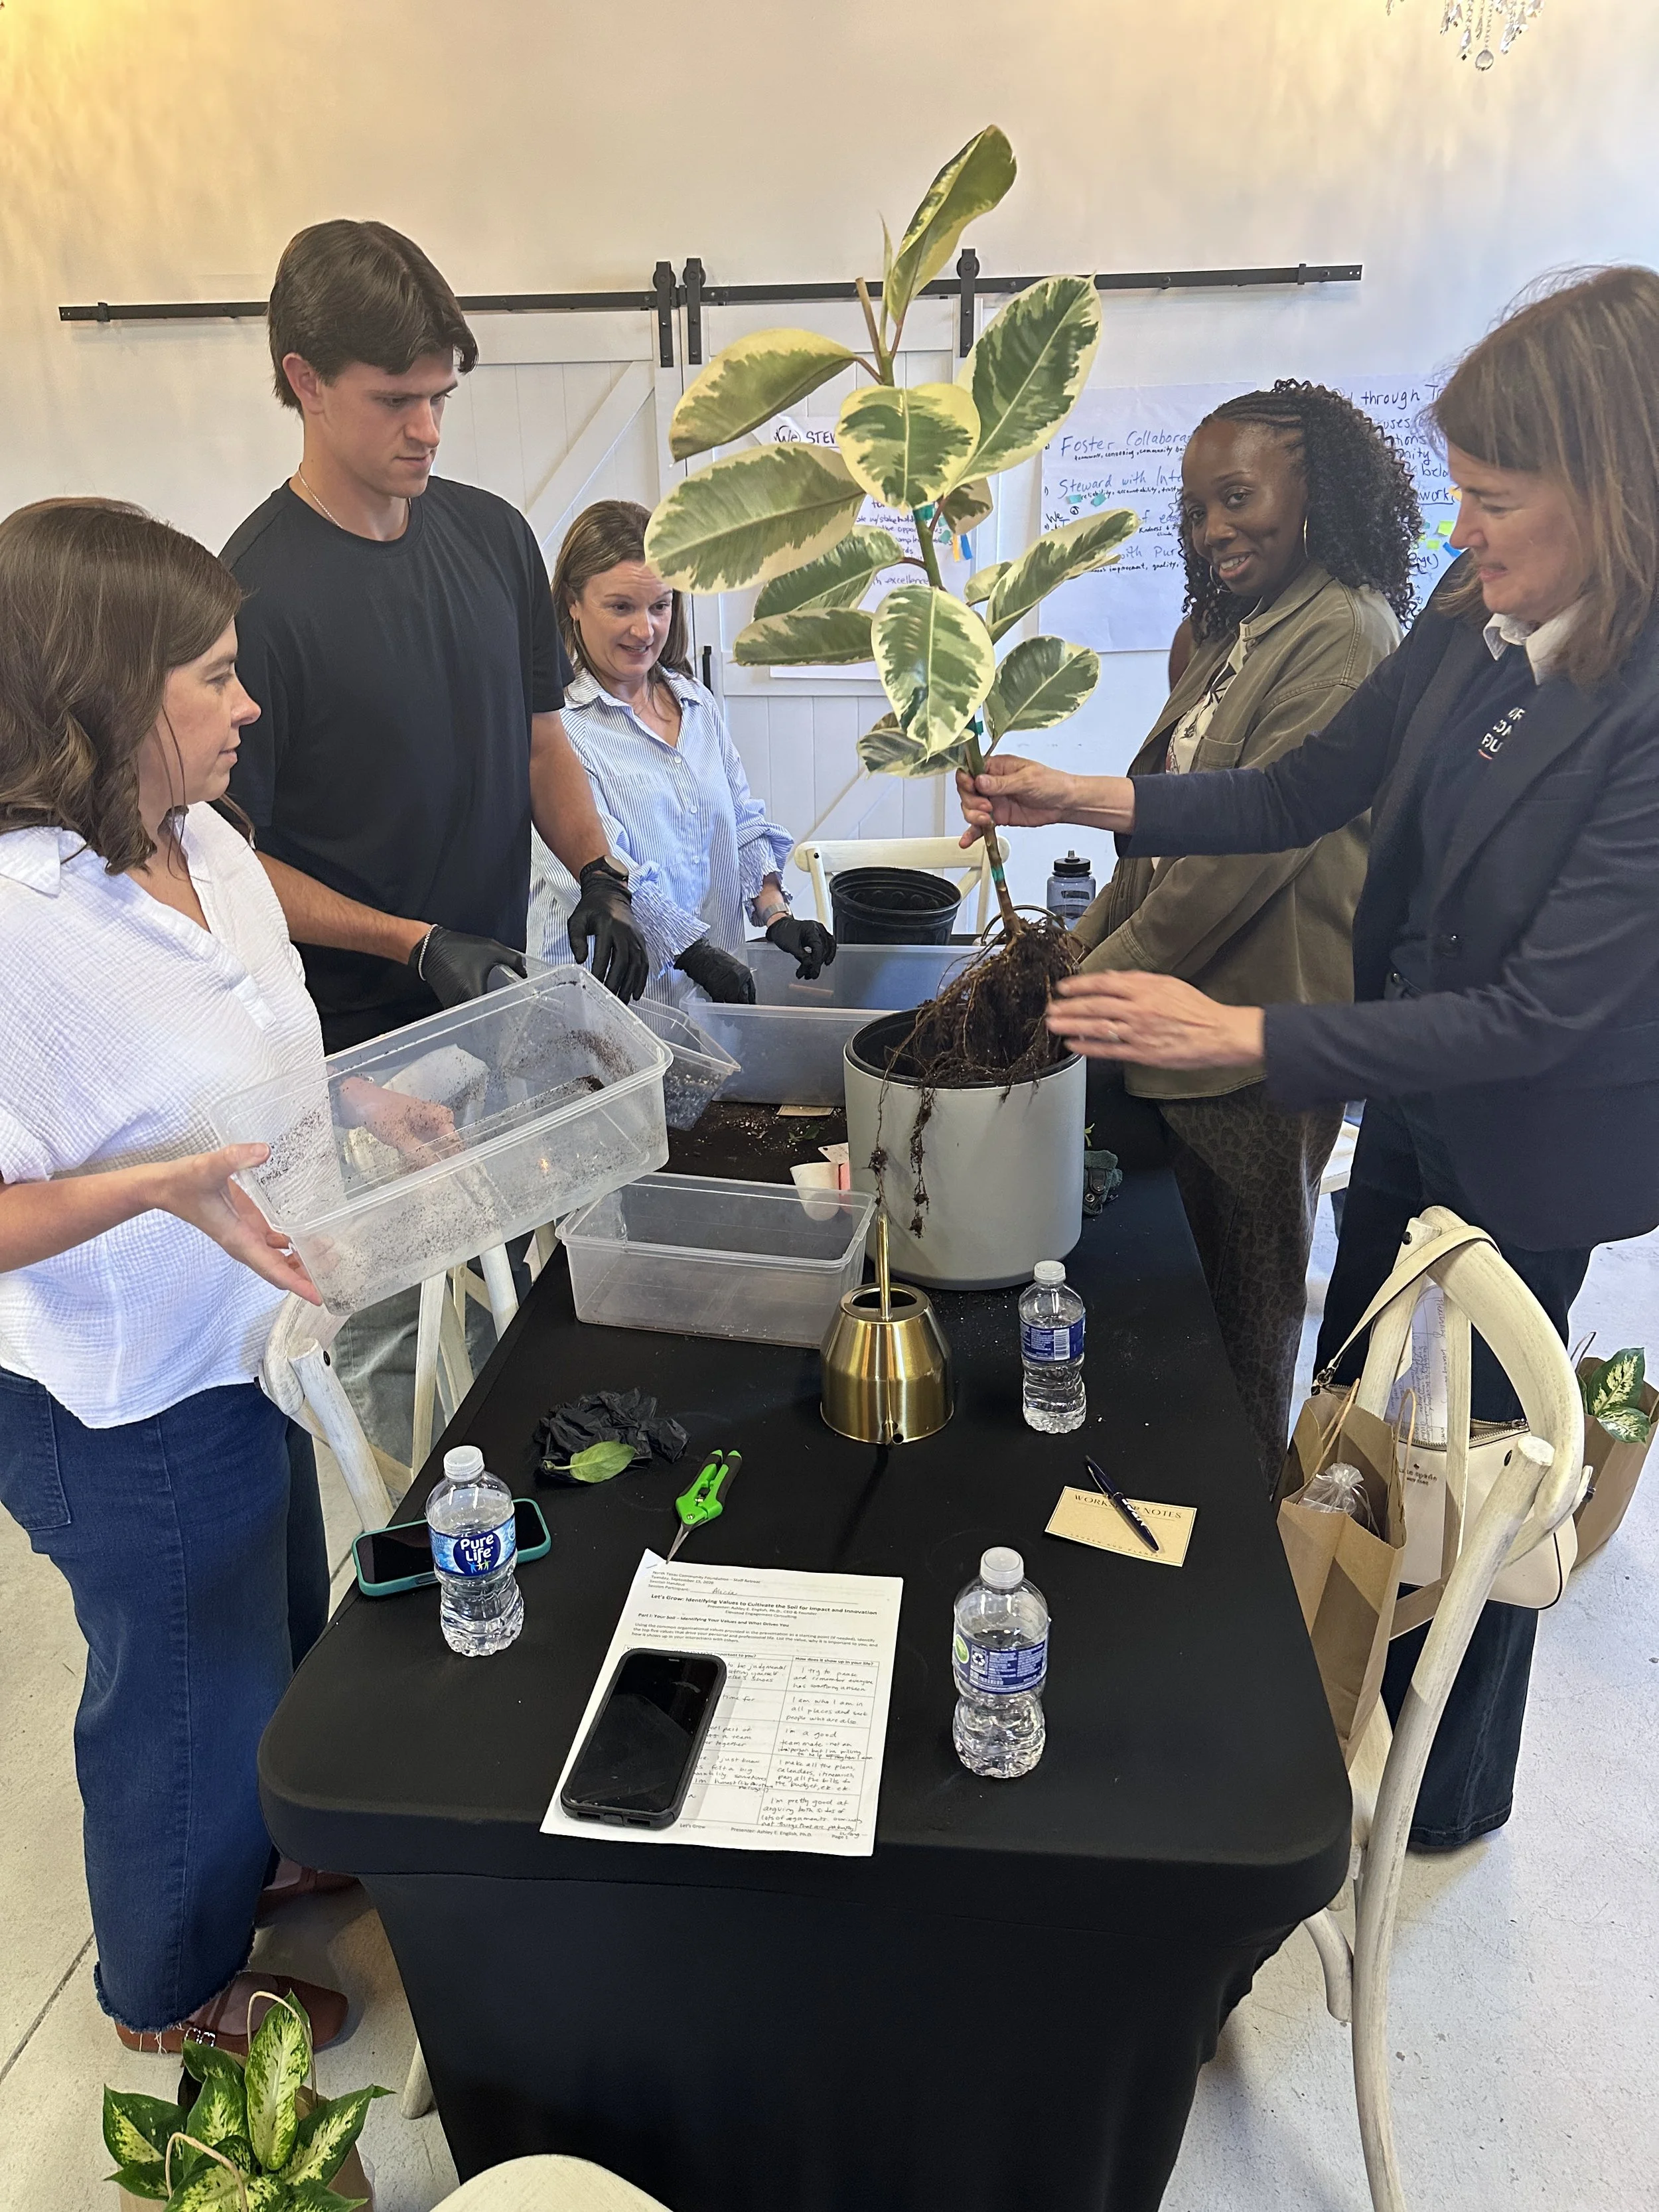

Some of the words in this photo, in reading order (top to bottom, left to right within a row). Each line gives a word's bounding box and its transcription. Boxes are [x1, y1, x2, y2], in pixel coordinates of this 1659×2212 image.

[1361, 390, 1420, 410] through
[1383, 418, 1409, 429] uses
[1060, 435, 1115, 457] Foster
[1058, 475, 1112, 499] Steward
[1121, 471, 1147, 486] with
[1419, 488, 1450, 502] work
[1075, 1494, 1140, 1511] WORKSP
[1143, 1508, 1182, 1519] NOTES
[460, 1534, 494, 1550] Pure
[465, 1547, 492, 1563] Life
